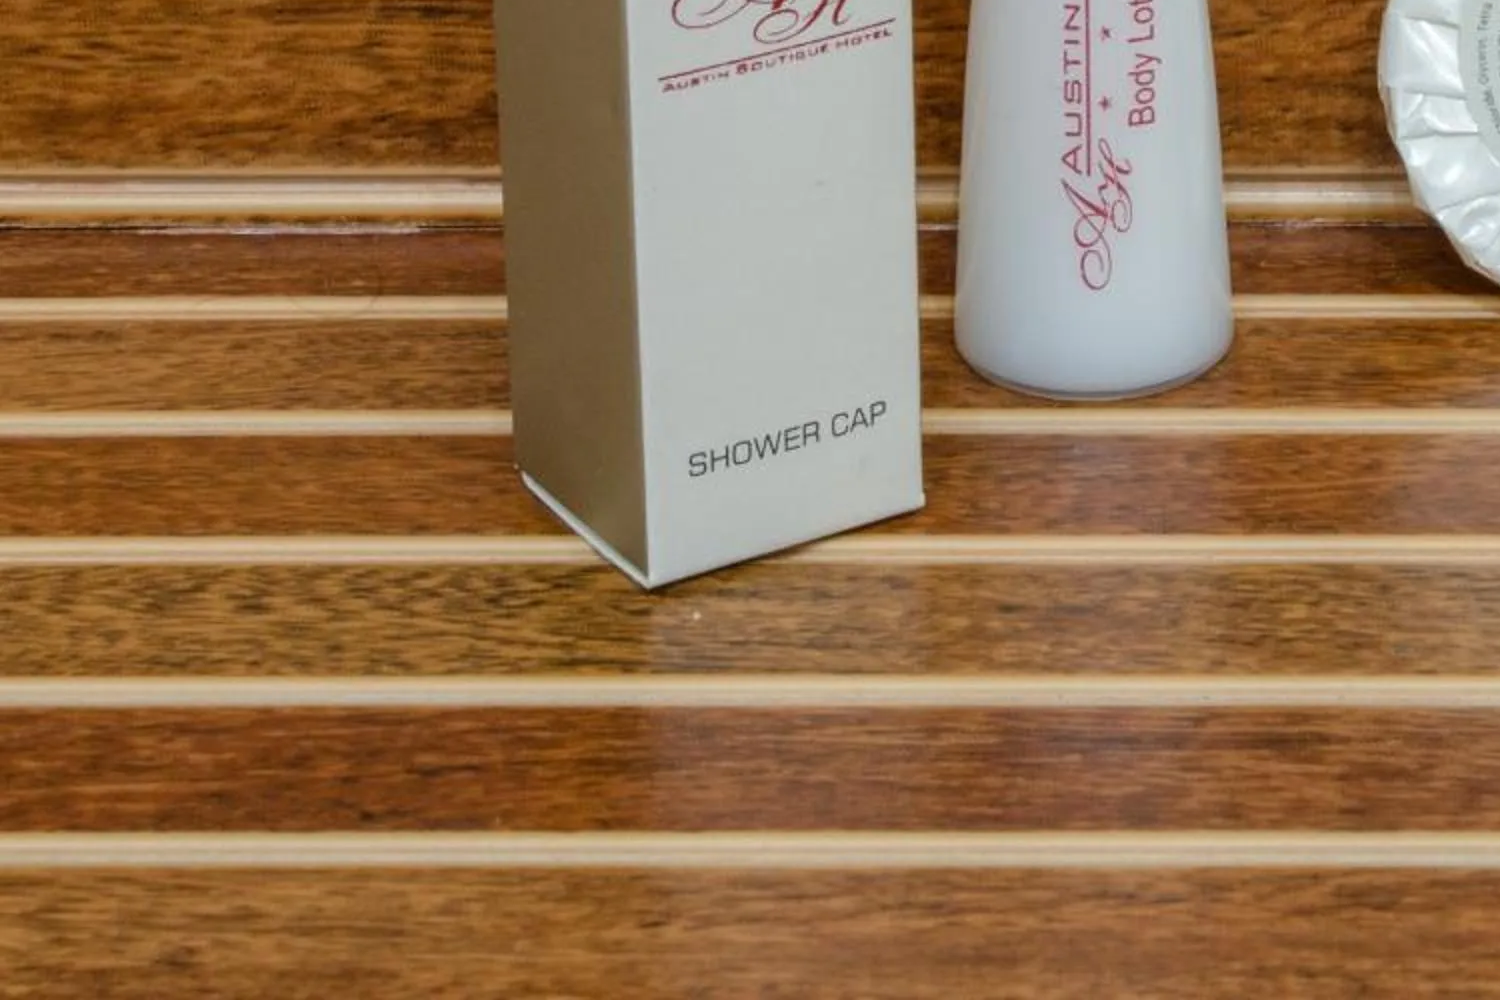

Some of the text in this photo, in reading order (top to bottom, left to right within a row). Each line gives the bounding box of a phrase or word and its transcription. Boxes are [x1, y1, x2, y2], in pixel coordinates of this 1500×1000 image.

[661, 29, 894, 93] AUSTIN BOUTIQUE HOTEL
[1060, 4, 1083, 175] AUSTIN
[1128, 51, 1163, 127] Body
[687, 400, 888, 478] SHOWER CAP
